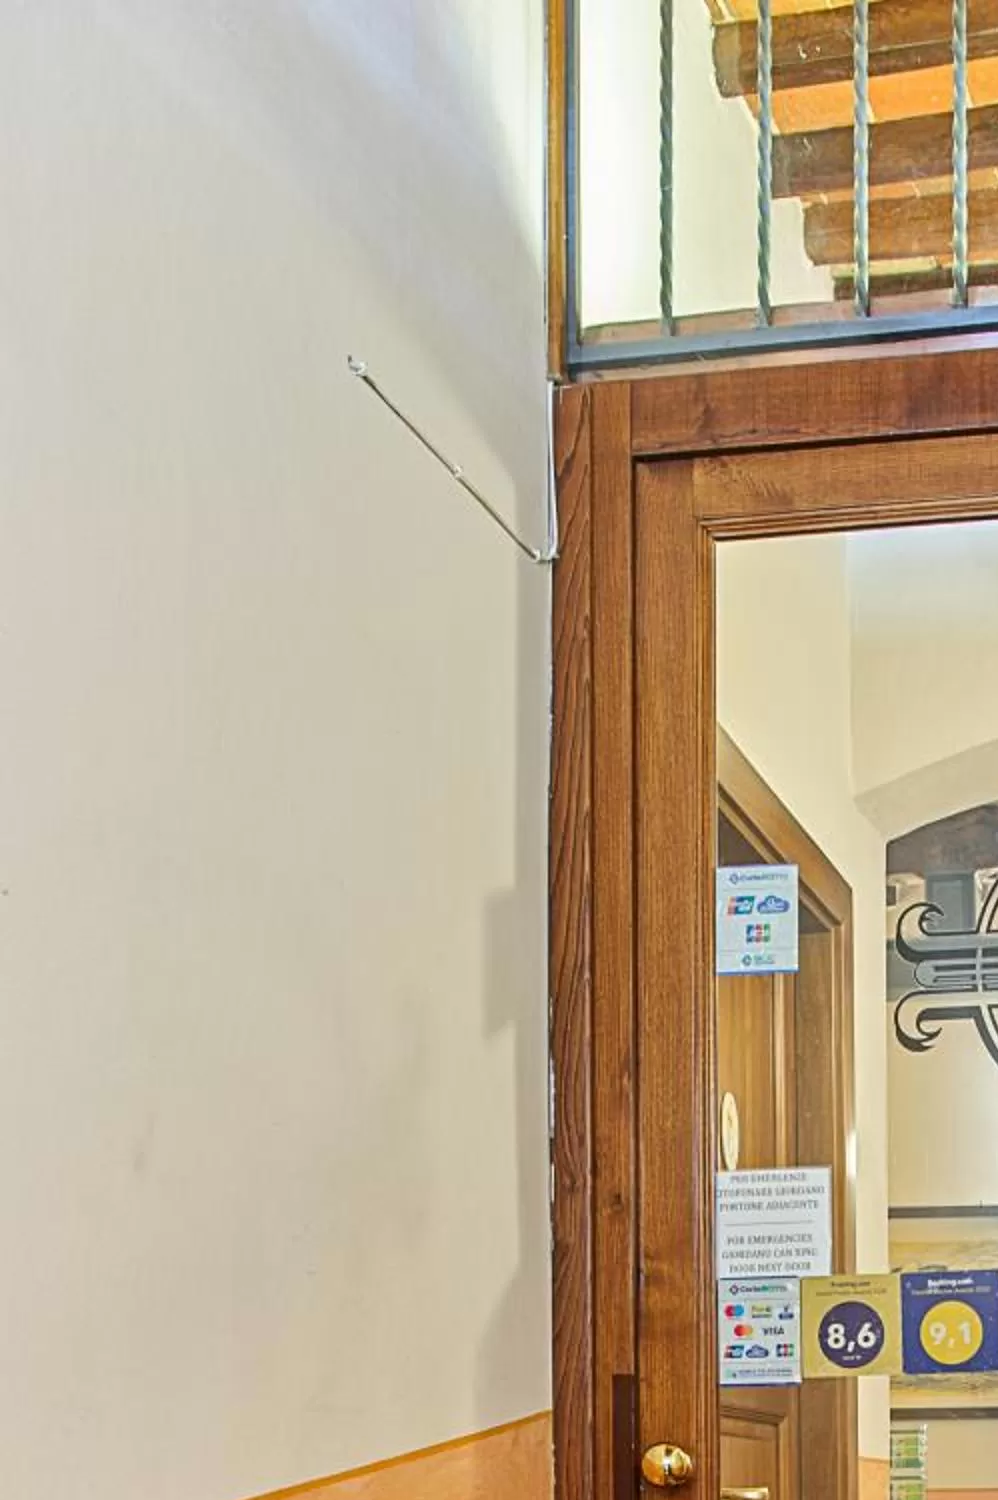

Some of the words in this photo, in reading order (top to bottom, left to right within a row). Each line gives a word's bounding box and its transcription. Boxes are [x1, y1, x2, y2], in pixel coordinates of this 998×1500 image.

[727, 1235, 745, 1245] FOR
[773, 1247, 793, 1258] CAN
[762, 1326, 785, 1336] VISA
[929, 1320, 972, 1348] 9,1
[827, 1322, 876, 1353] 8,6
